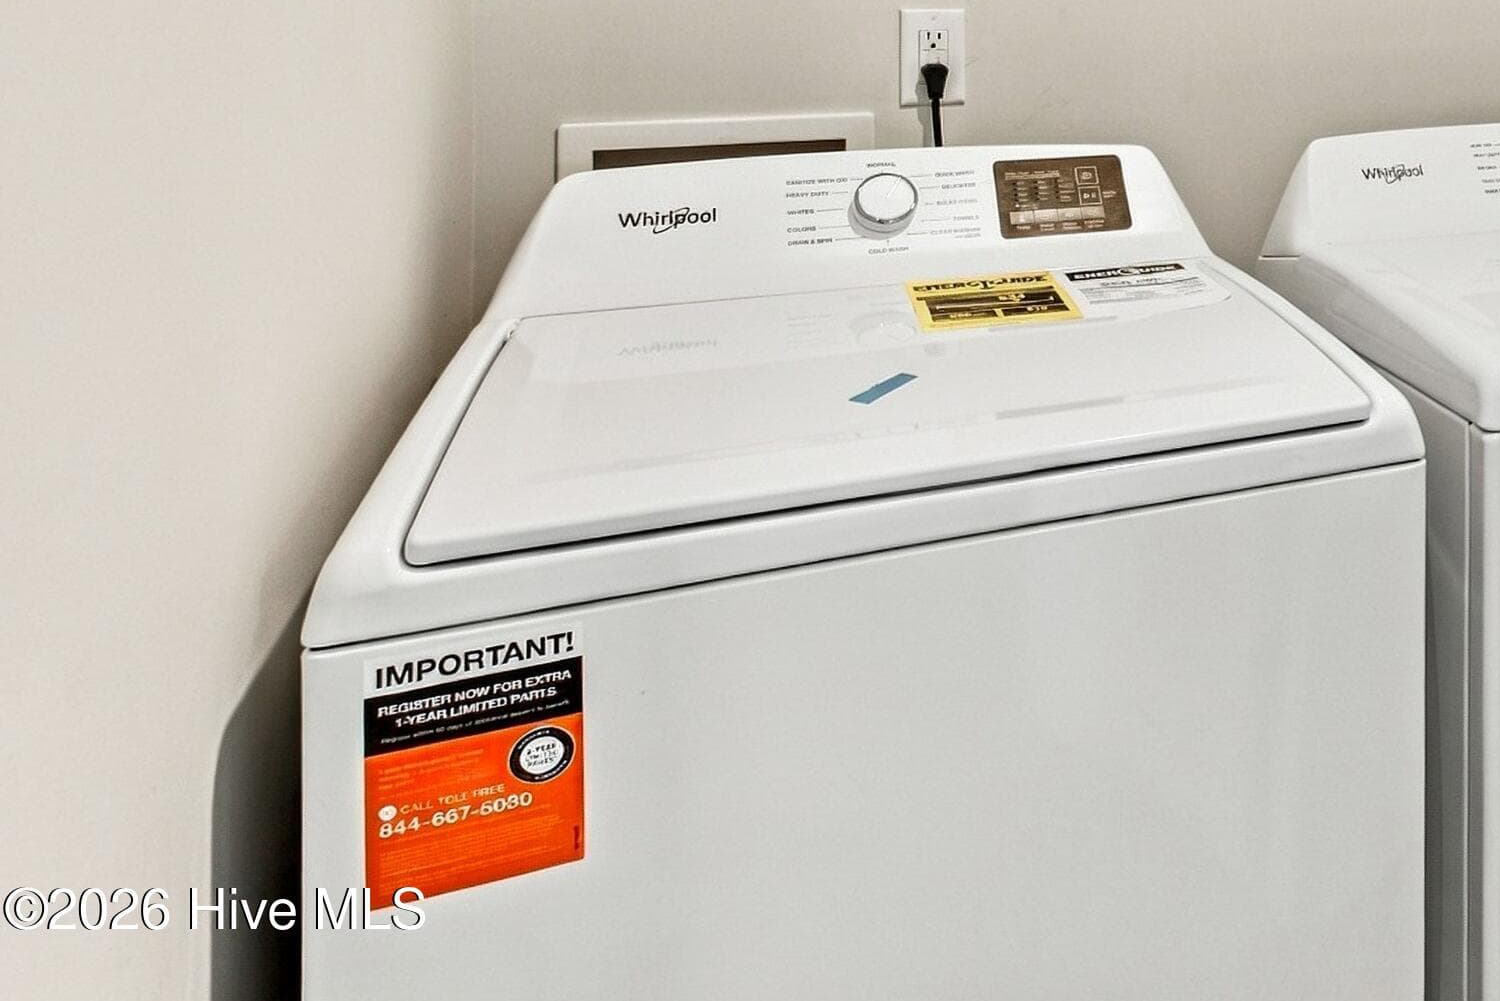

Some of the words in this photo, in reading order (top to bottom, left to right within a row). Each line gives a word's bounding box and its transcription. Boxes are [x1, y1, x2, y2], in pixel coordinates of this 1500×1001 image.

[1361, 163, 1424, 184] Whirlpool
[618, 206, 717, 234] Whirlpool
[376, 631, 575, 689] IMPORTANT!
[376, 694, 452, 718] REGISTER
[454, 685, 491, 702] NOW
[492, 679, 522, 694] FOR
[524, 669, 572, 687] EXTRA
[395, 708, 448, 728] 1-YEAR
[450, 696, 508, 718] LIMITED
[510, 686, 558, 704] PARTS
[400, 801, 433, 815] CALL
